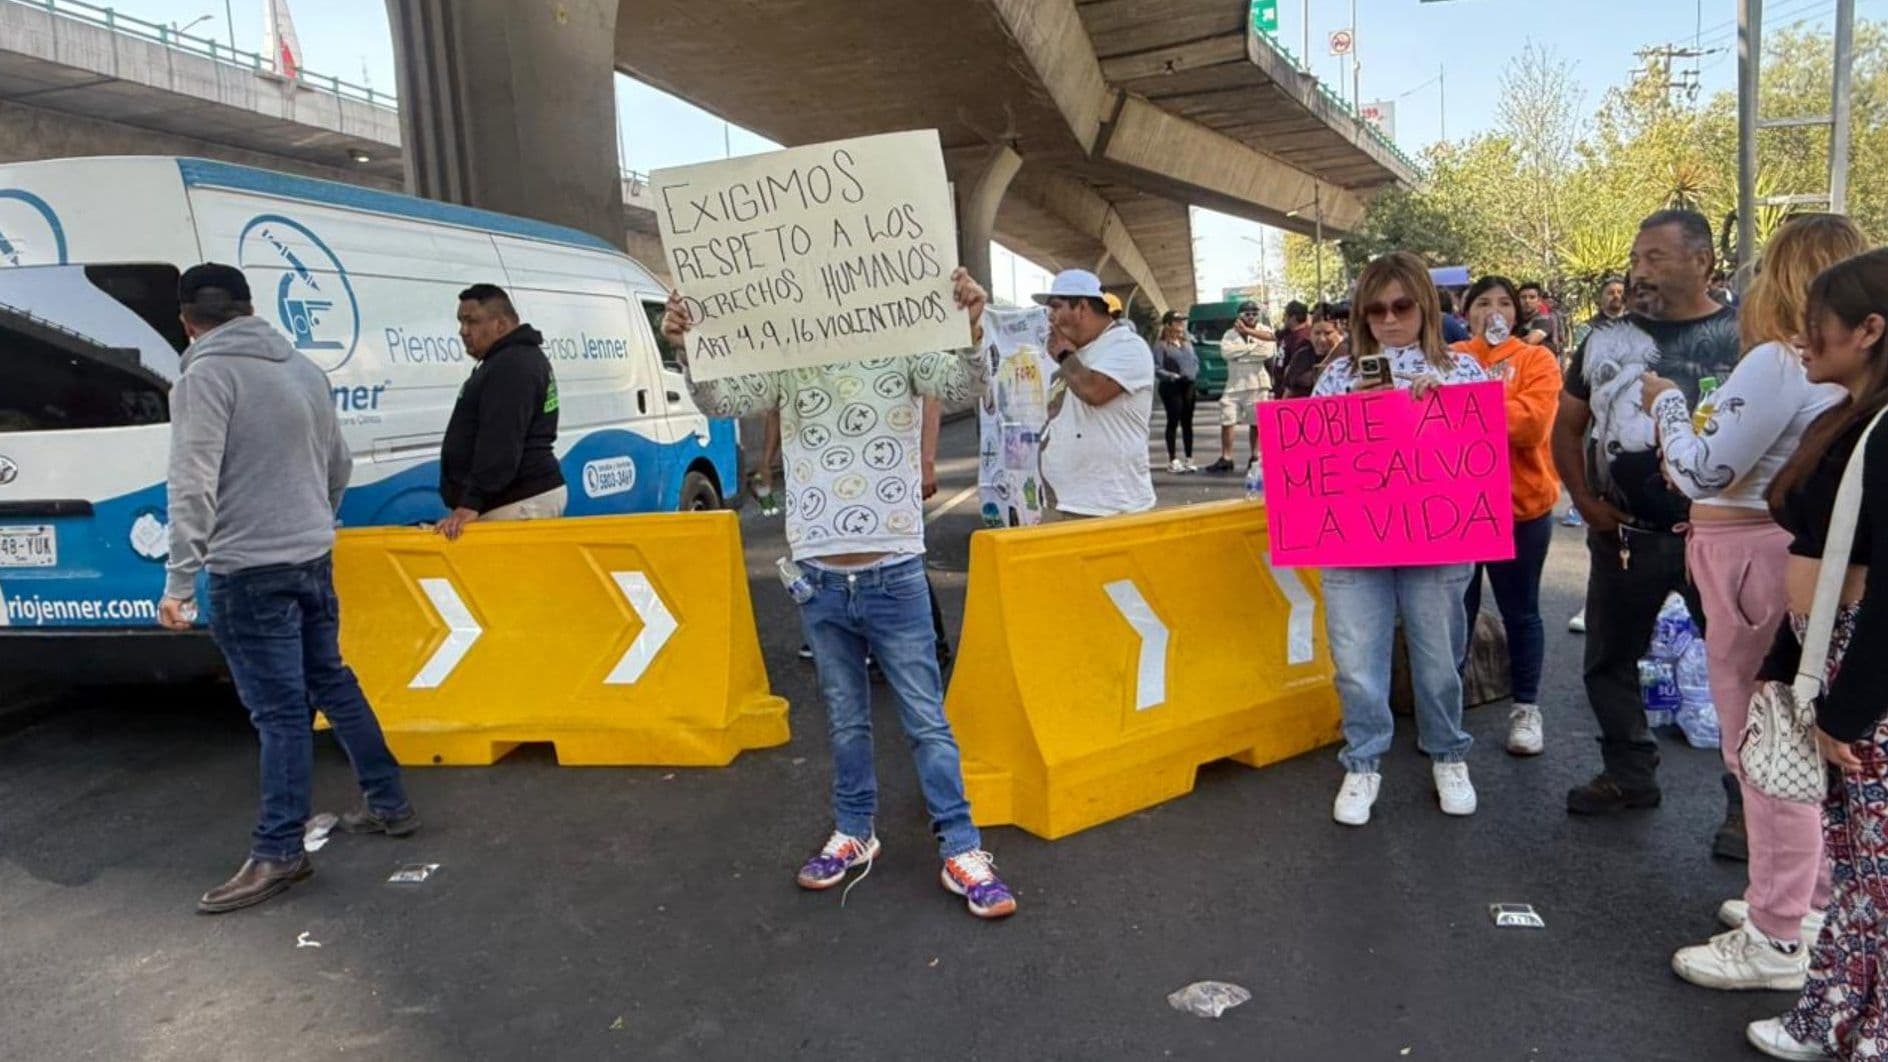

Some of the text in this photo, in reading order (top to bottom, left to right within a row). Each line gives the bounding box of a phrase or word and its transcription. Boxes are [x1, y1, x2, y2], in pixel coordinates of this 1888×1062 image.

[662, 149, 864, 235] EXIGIMOS
[672, 203, 923, 284] RESPETO A LOS
[684, 242, 941, 326] DERECHOS HUMANOS
[384, 327, 464, 364] Piensa
[580, 331, 630, 360] Jenner
[695, 334, 732, 360] ART
[816, 290, 947, 338] VIOLENTADOS
[1276, 395, 1389, 451] DOBLE
[1282, 439, 1498, 498] ME SALVO
[1278, 491, 1501, 551] LA VIDA
